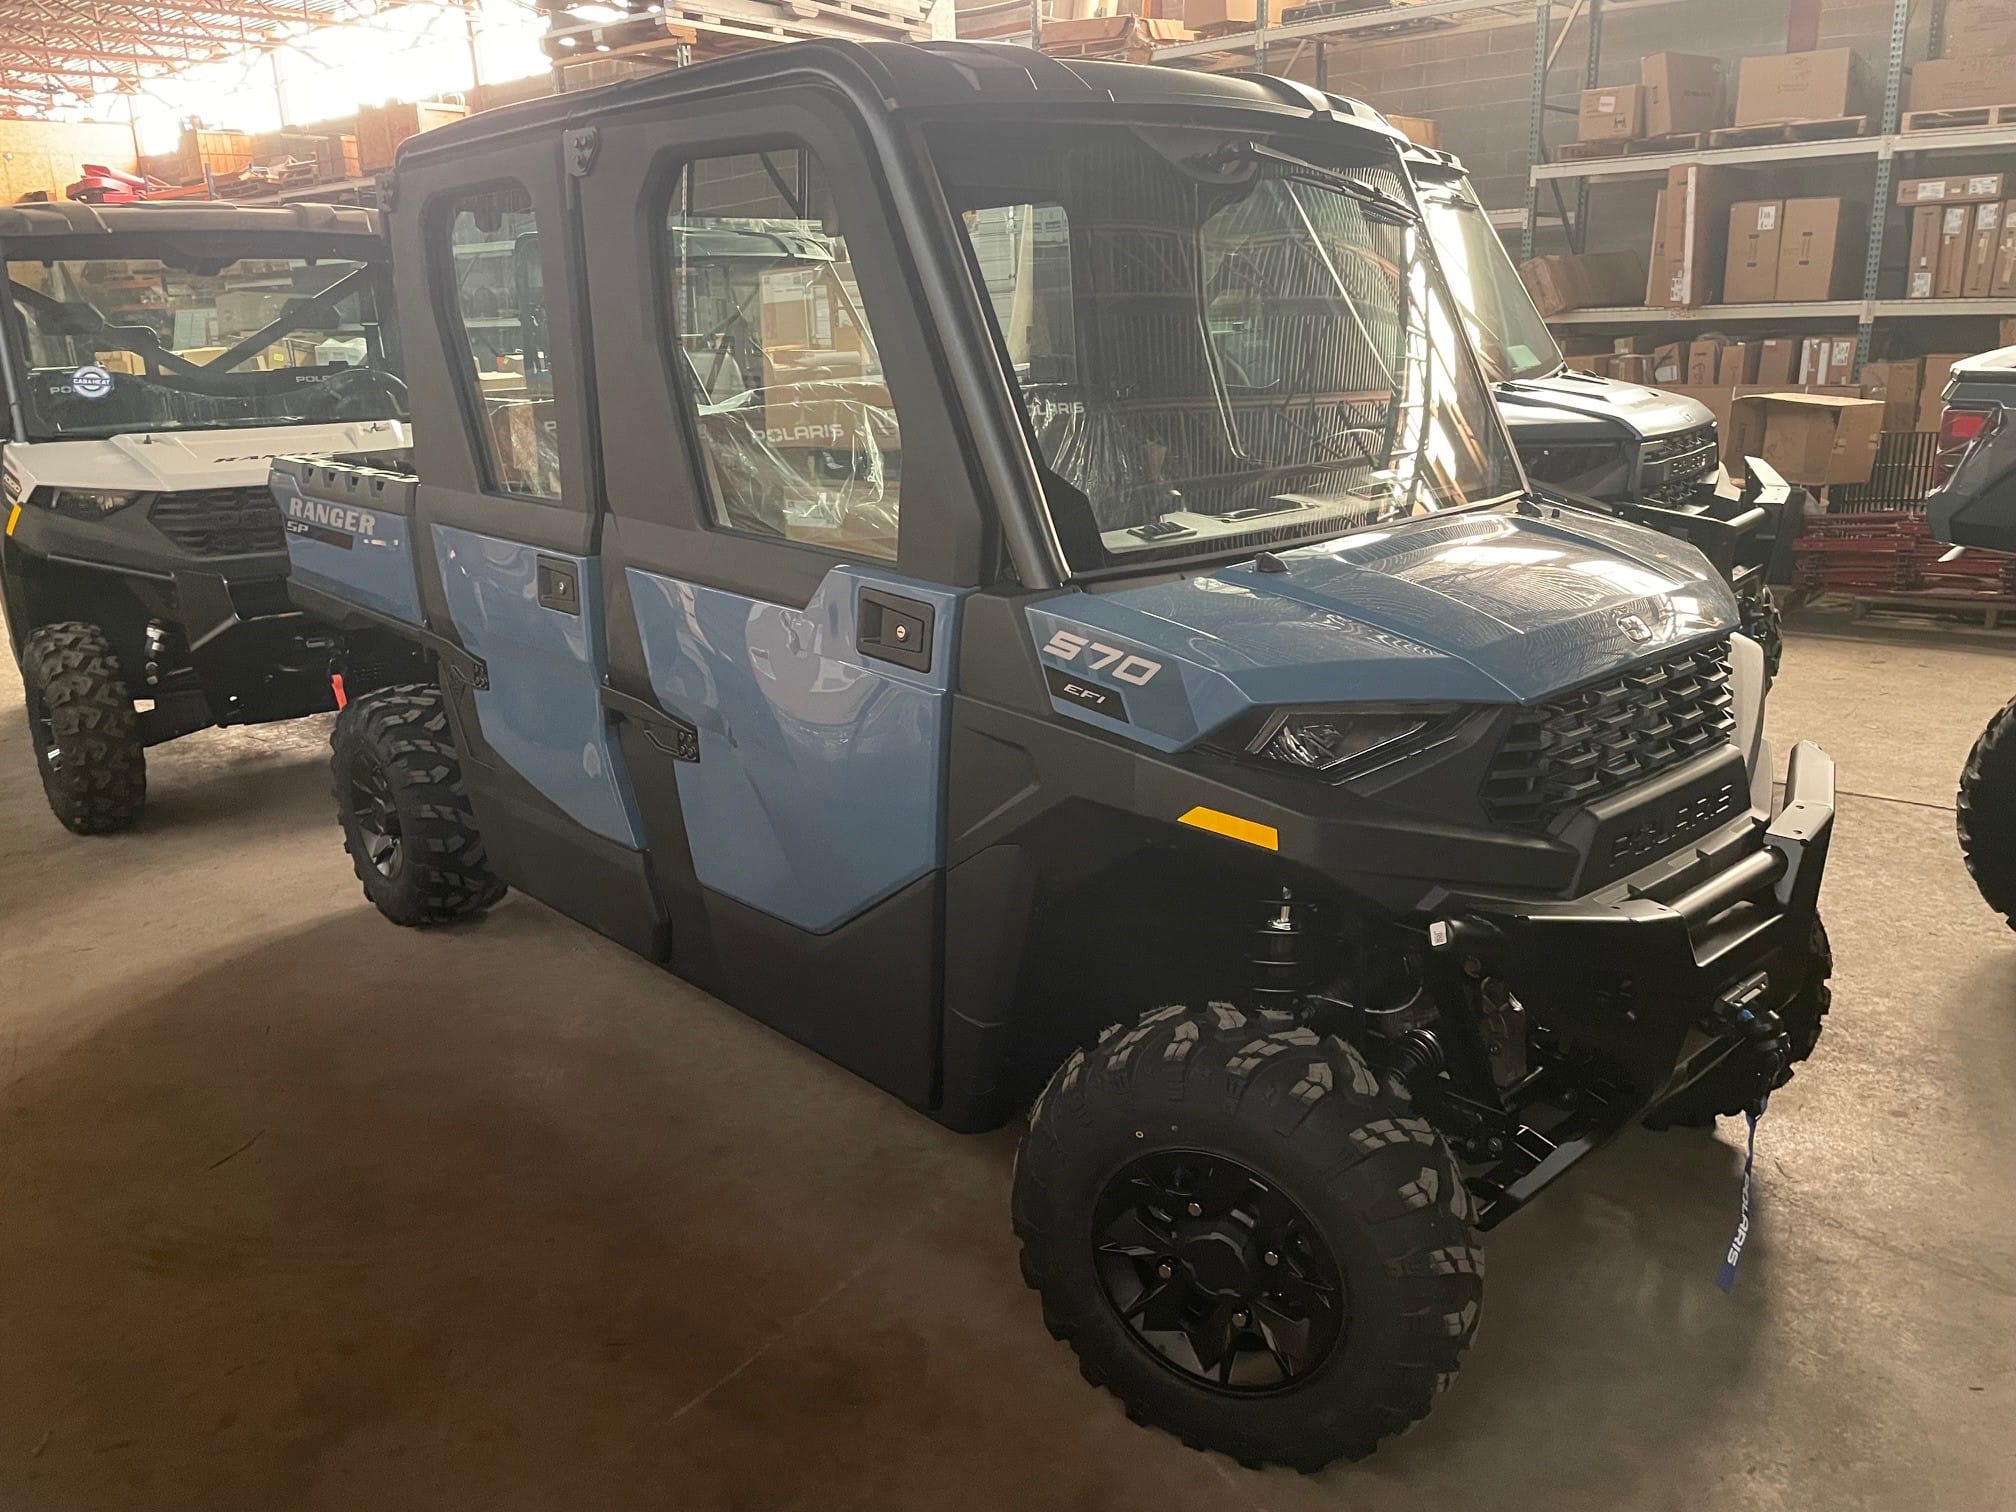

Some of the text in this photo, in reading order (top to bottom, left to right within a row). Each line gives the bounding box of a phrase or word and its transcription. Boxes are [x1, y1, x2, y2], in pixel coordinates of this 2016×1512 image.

[752, 424, 844, 442] POLARIS
[286, 520, 309, 533] SP
[289, 497, 376, 535] RANGER
[1042, 630, 1162, 686] 570
[1063, 683, 1106, 704] EFI
[1727, 1171, 1750, 1267] POLARIS
